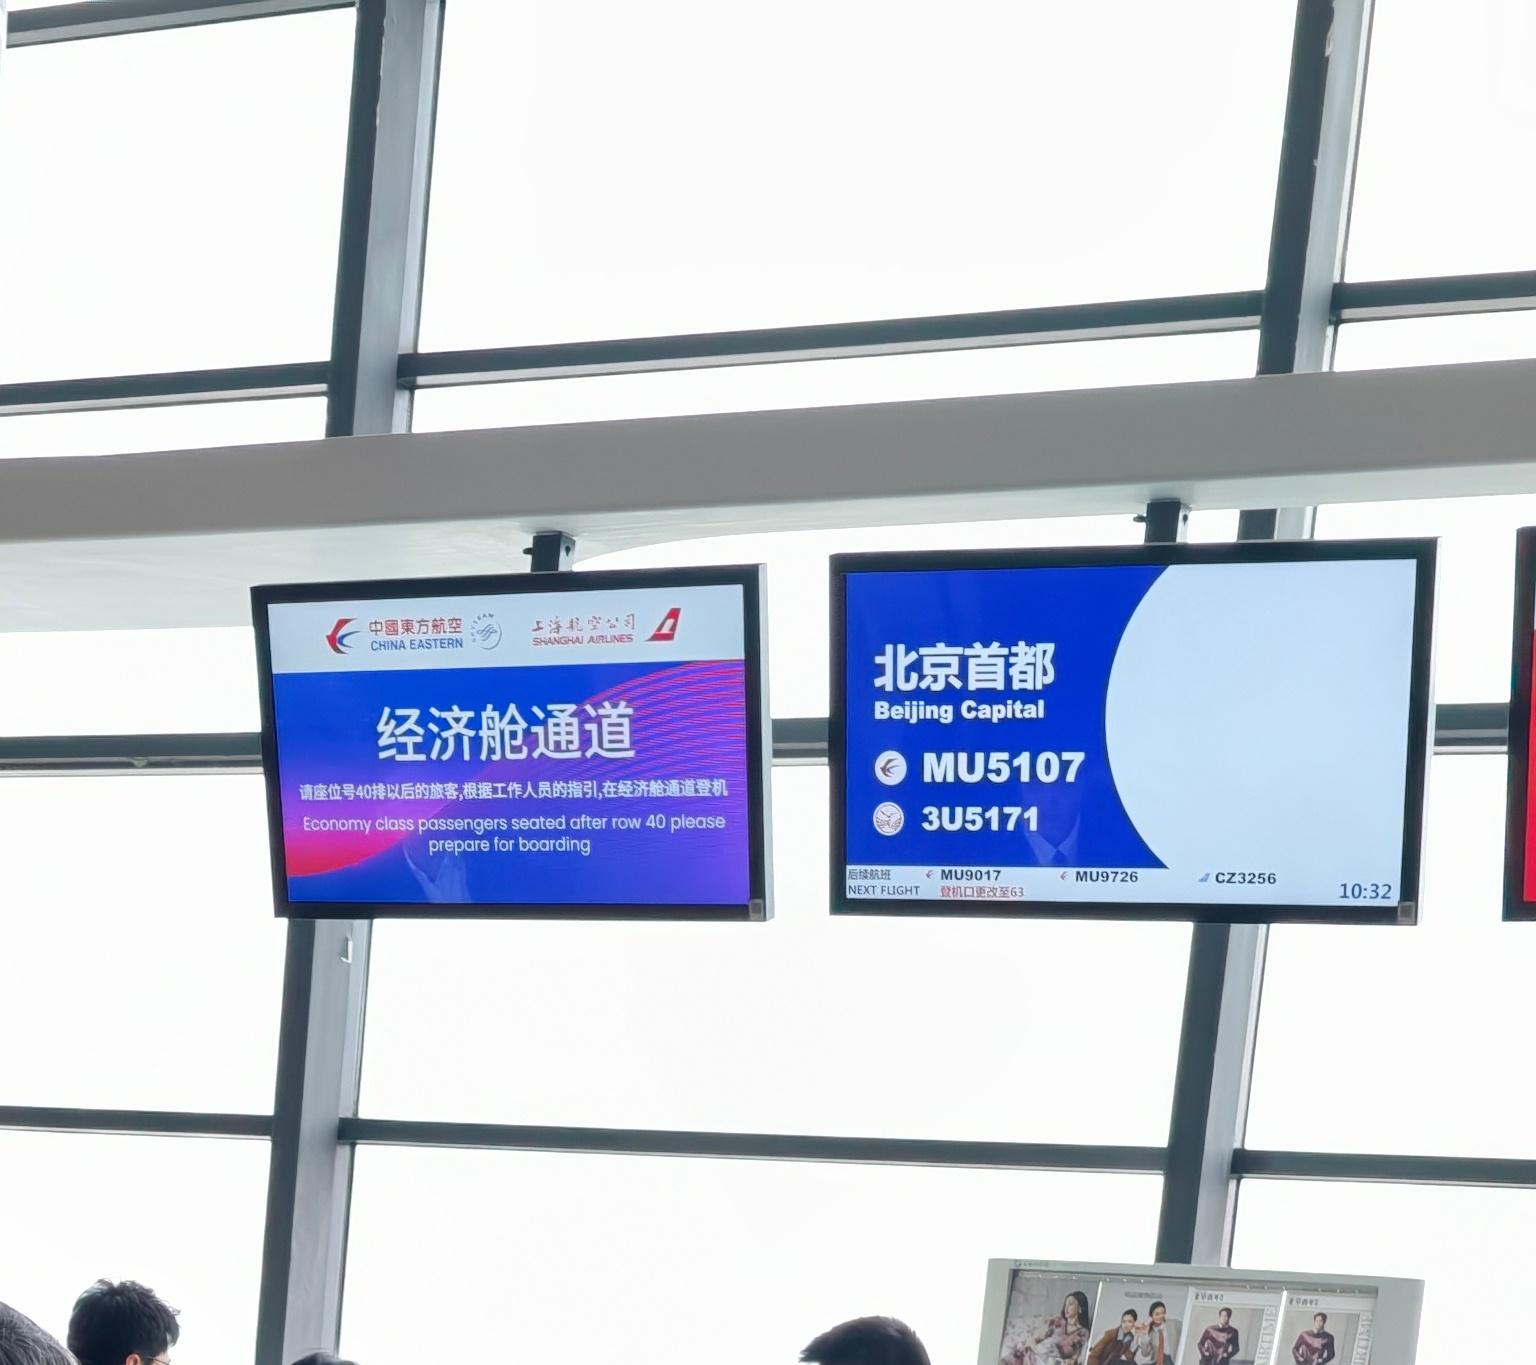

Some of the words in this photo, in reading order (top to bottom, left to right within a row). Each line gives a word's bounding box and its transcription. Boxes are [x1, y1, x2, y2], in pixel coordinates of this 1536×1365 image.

[368, 616, 463, 636] 中國東方航空
[370, 639, 407, 652] CHINA
[409, 637, 464, 651] EASTERN
[532, 634, 585, 647] SHANGHAI
[587, 633, 634, 645] AIRLINES
[873, 641, 1056, 692] 北京首都
[874, 700, 954, 724] Beijing
[960, 699, 1045, 724] Capital
[375, 700, 636, 763] 经济舱通道
[922, 751, 1086, 784] MU5107
[303, 815, 372, 834] Economy
[375, 815, 414, 831] class
[417, 816, 507, 835] passengers
[511, 814, 566, 831] seated
[569, 813, 607, 830] after
[611, 816, 642, 830] row
[645, 814, 665, 829] 40
[670, 813, 726, 833] please
[921, 806, 1039, 832] 3U5171
[428, 839, 489, 856] prepare
[493, 836, 515, 852] for
[518, 836, 591, 856] boarding
[848, 868, 892, 881] 后续航班
[940, 869, 1001, 881] MU9017
[1075, 870, 1139, 883] MU9726
[1215, 872, 1277, 884] CZ3256
[848, 885, 877, 896] NEXT
[881, 885, 920, 896] FLIGHT
[940, 886, 1024, 899] 登机口更改至63
[1339, 883, 1392, 900] 10:32
